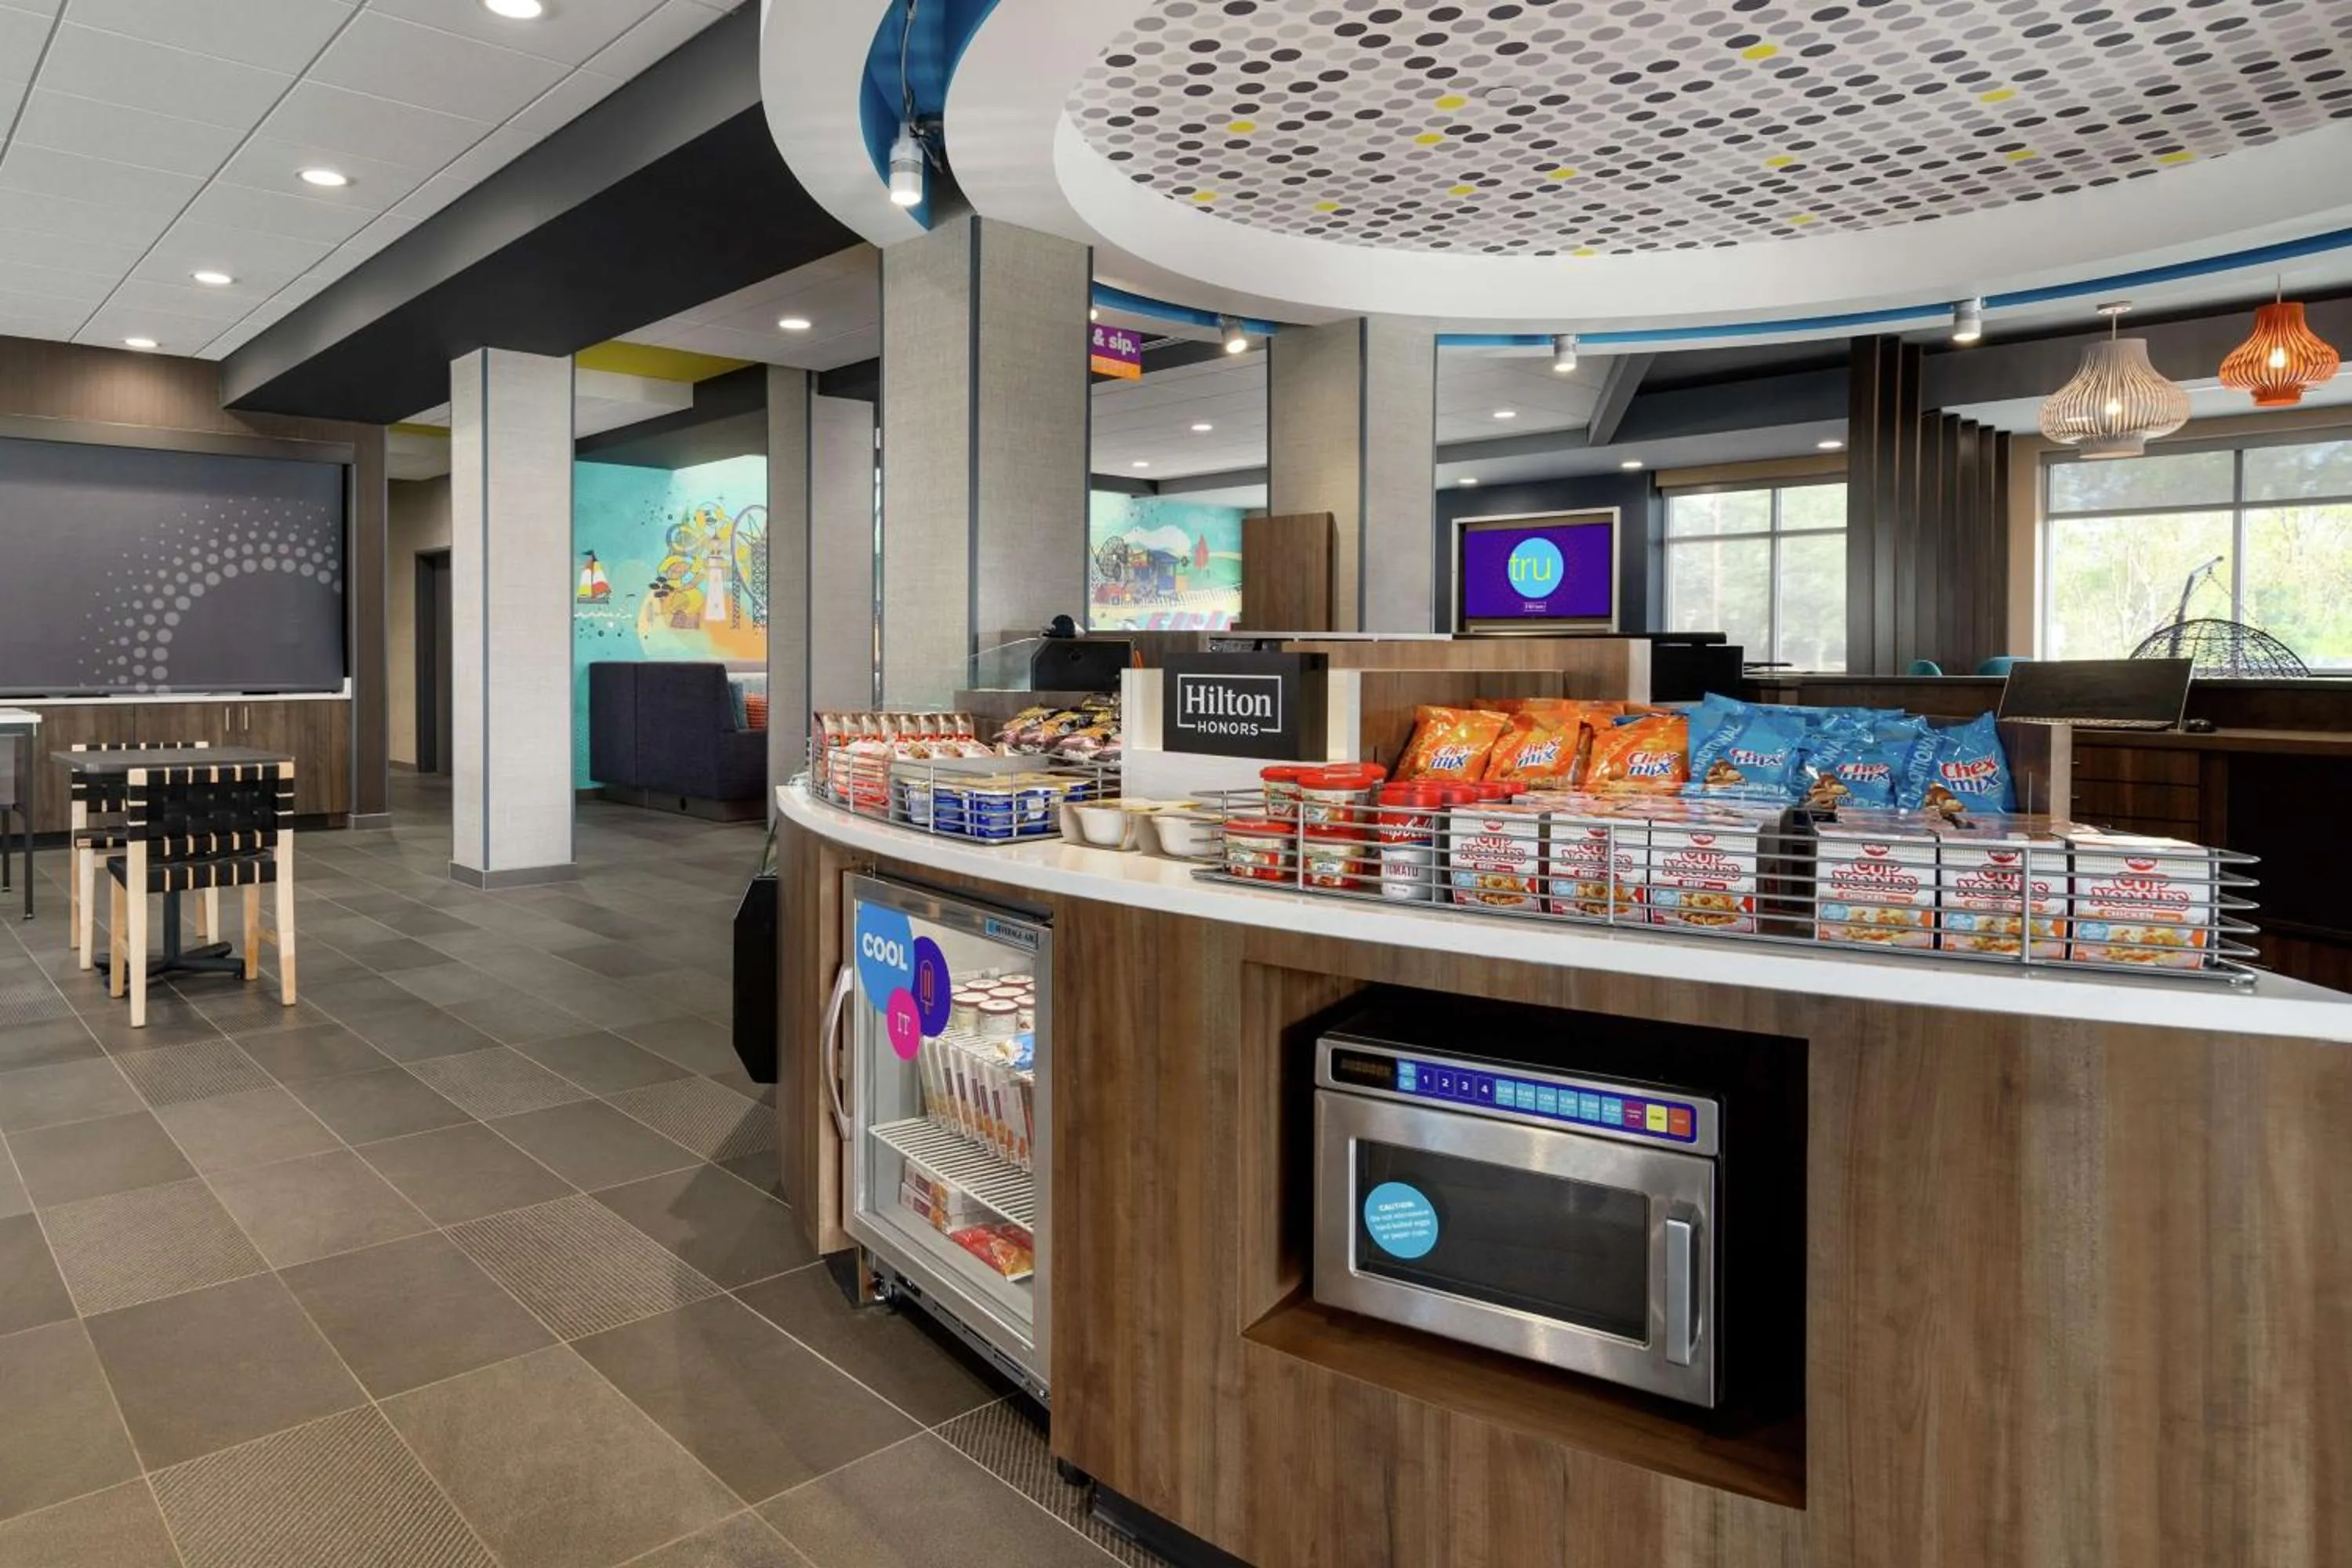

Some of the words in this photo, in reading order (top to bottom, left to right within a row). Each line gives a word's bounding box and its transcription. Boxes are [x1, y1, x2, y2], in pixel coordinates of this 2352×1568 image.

[1093, 328, 1105, 347] &
[1109, 331, 1135, 355] sip.
[1508, 551, 1552, 580] tru
[1185, 684, 1272, 717] Hilton
[1197, 720, 1259, 736] HONORS
[1940, 757, 1998, 779] Chex
[1949, 775, 1999, 794] mix
[862, 932, 909, 971] COOL
[897, 1011, 910, 1036] IT
[1423, 1075, 1428, 1084] 1
[1442, 1078, 1450, 1087] 2
[1461, 1081, 1468, 1091] 3
[1481, 1084, 1489, 1094] 4
